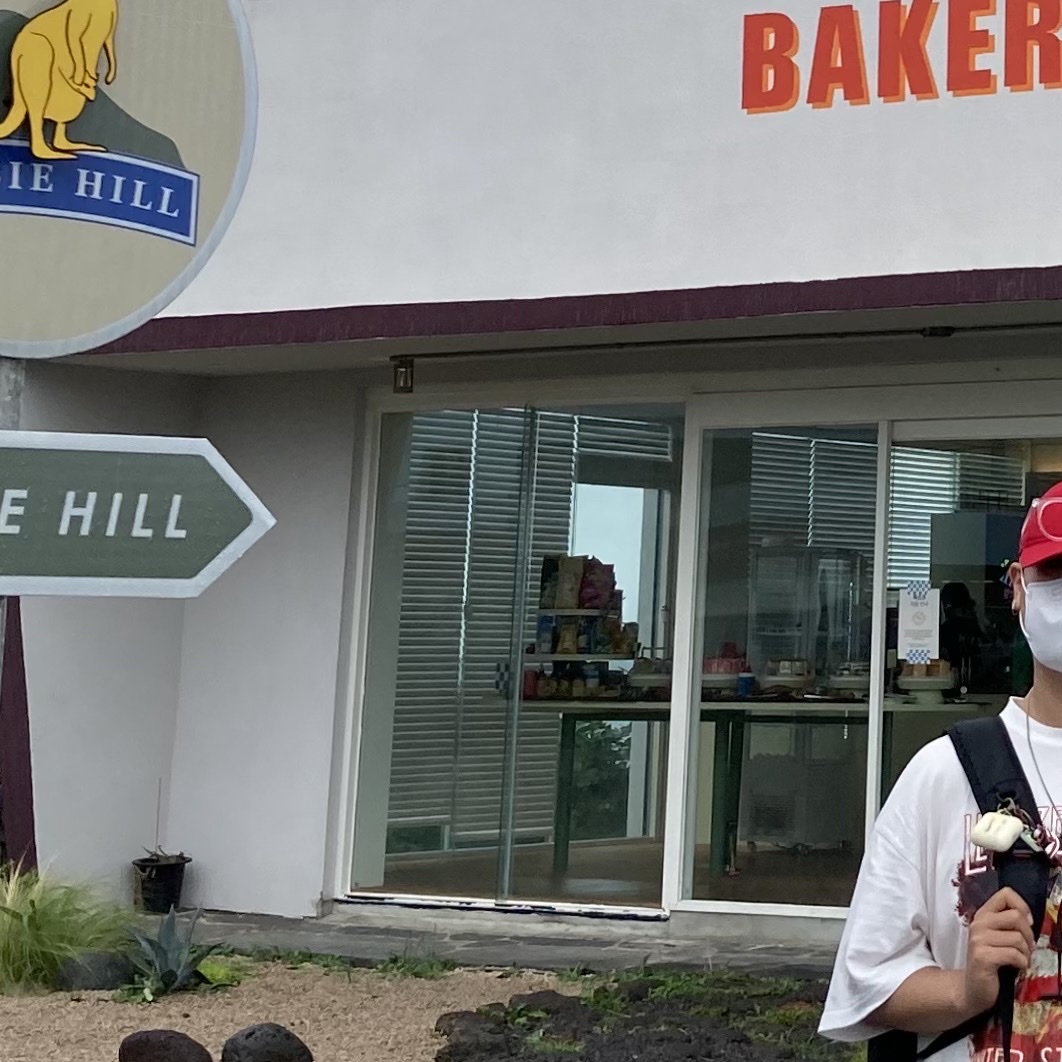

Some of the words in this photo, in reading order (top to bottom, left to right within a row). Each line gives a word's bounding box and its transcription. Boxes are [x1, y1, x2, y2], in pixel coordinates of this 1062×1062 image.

[0, 161, 53, 193] IE
[74, 168, 180, 218] HILL
[58, 490, 187, 539] HILL
